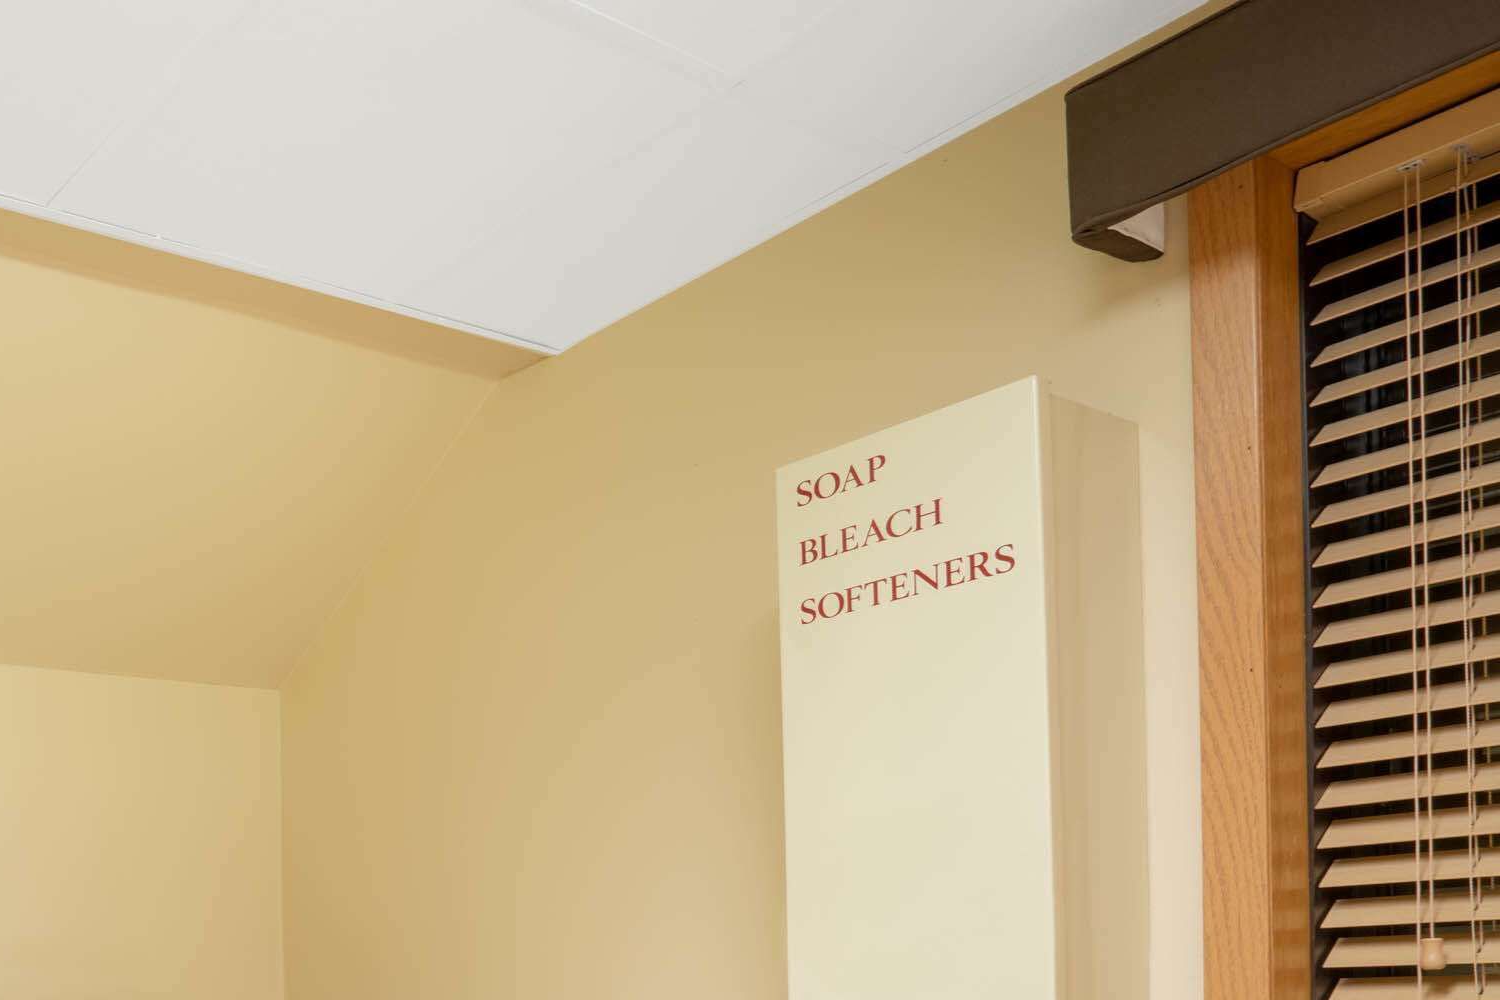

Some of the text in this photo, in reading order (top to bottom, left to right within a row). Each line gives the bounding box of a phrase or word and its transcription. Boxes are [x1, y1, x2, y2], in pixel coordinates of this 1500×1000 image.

[796, 454, 886, 507] SOAP
[798, 497, 943, 567] BLEACH
[801, 543, 1016, 625] SOFTENERS
